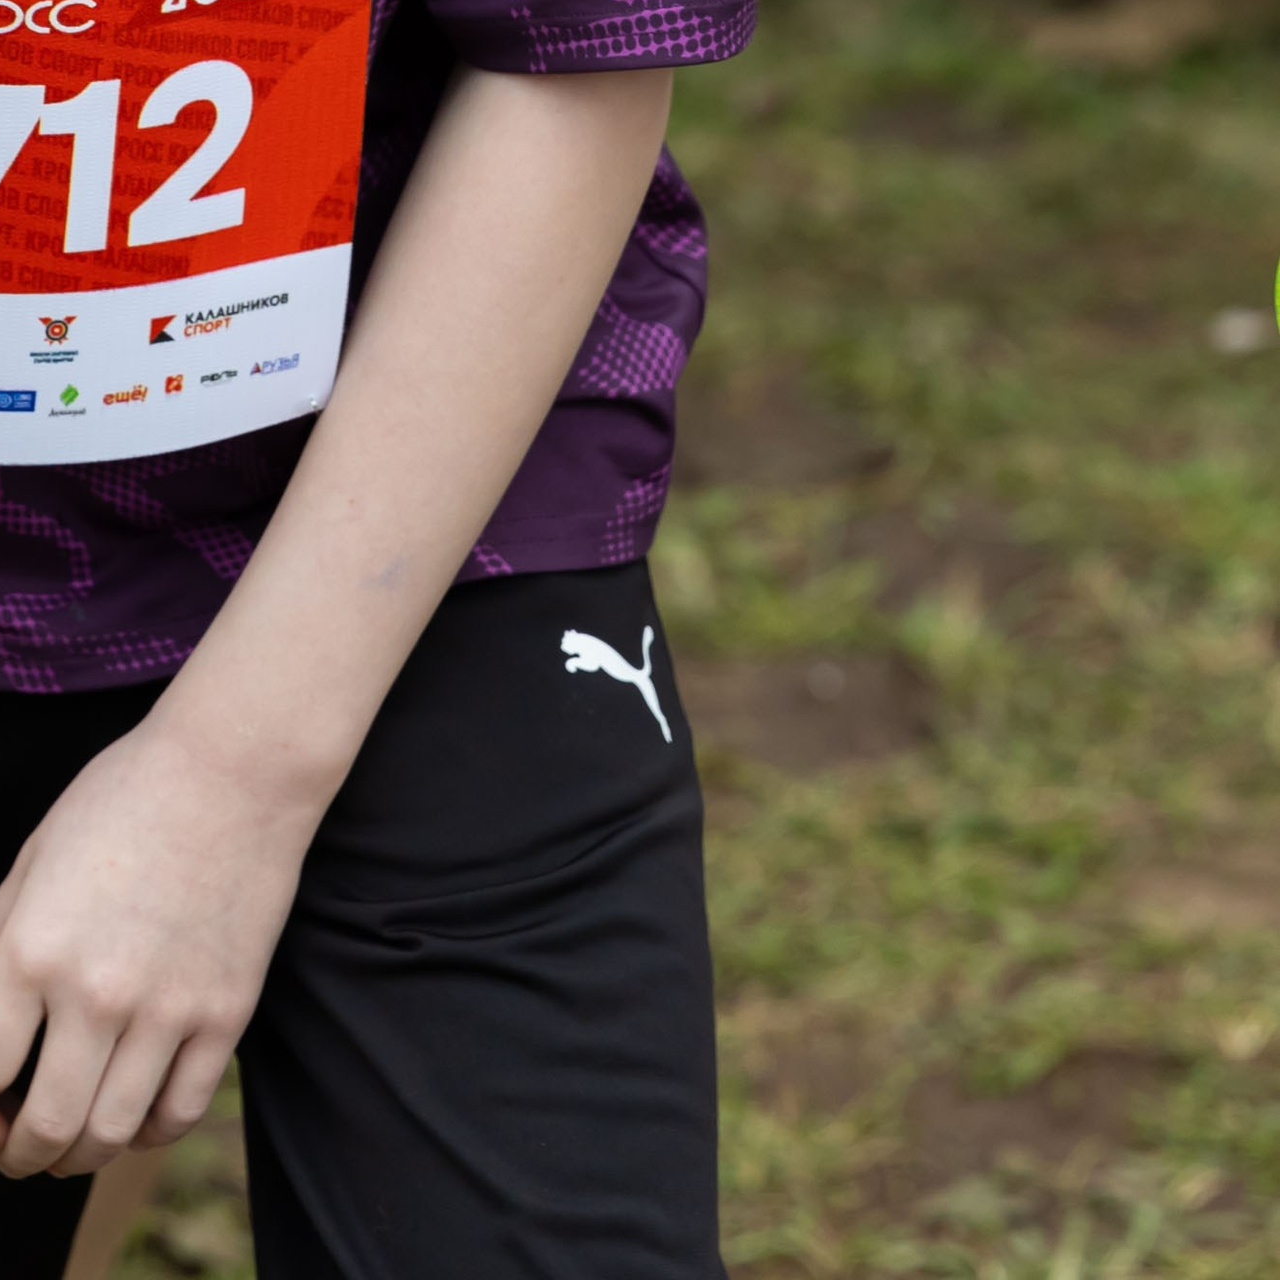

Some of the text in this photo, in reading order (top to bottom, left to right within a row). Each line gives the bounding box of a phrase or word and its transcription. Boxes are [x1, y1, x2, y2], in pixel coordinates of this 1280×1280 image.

[185, 293, 290, 325] КАЛАШНИКОВ
[183, 316, 234, 338] СПОРТ
[103, 384, 149, 406] ещё!
